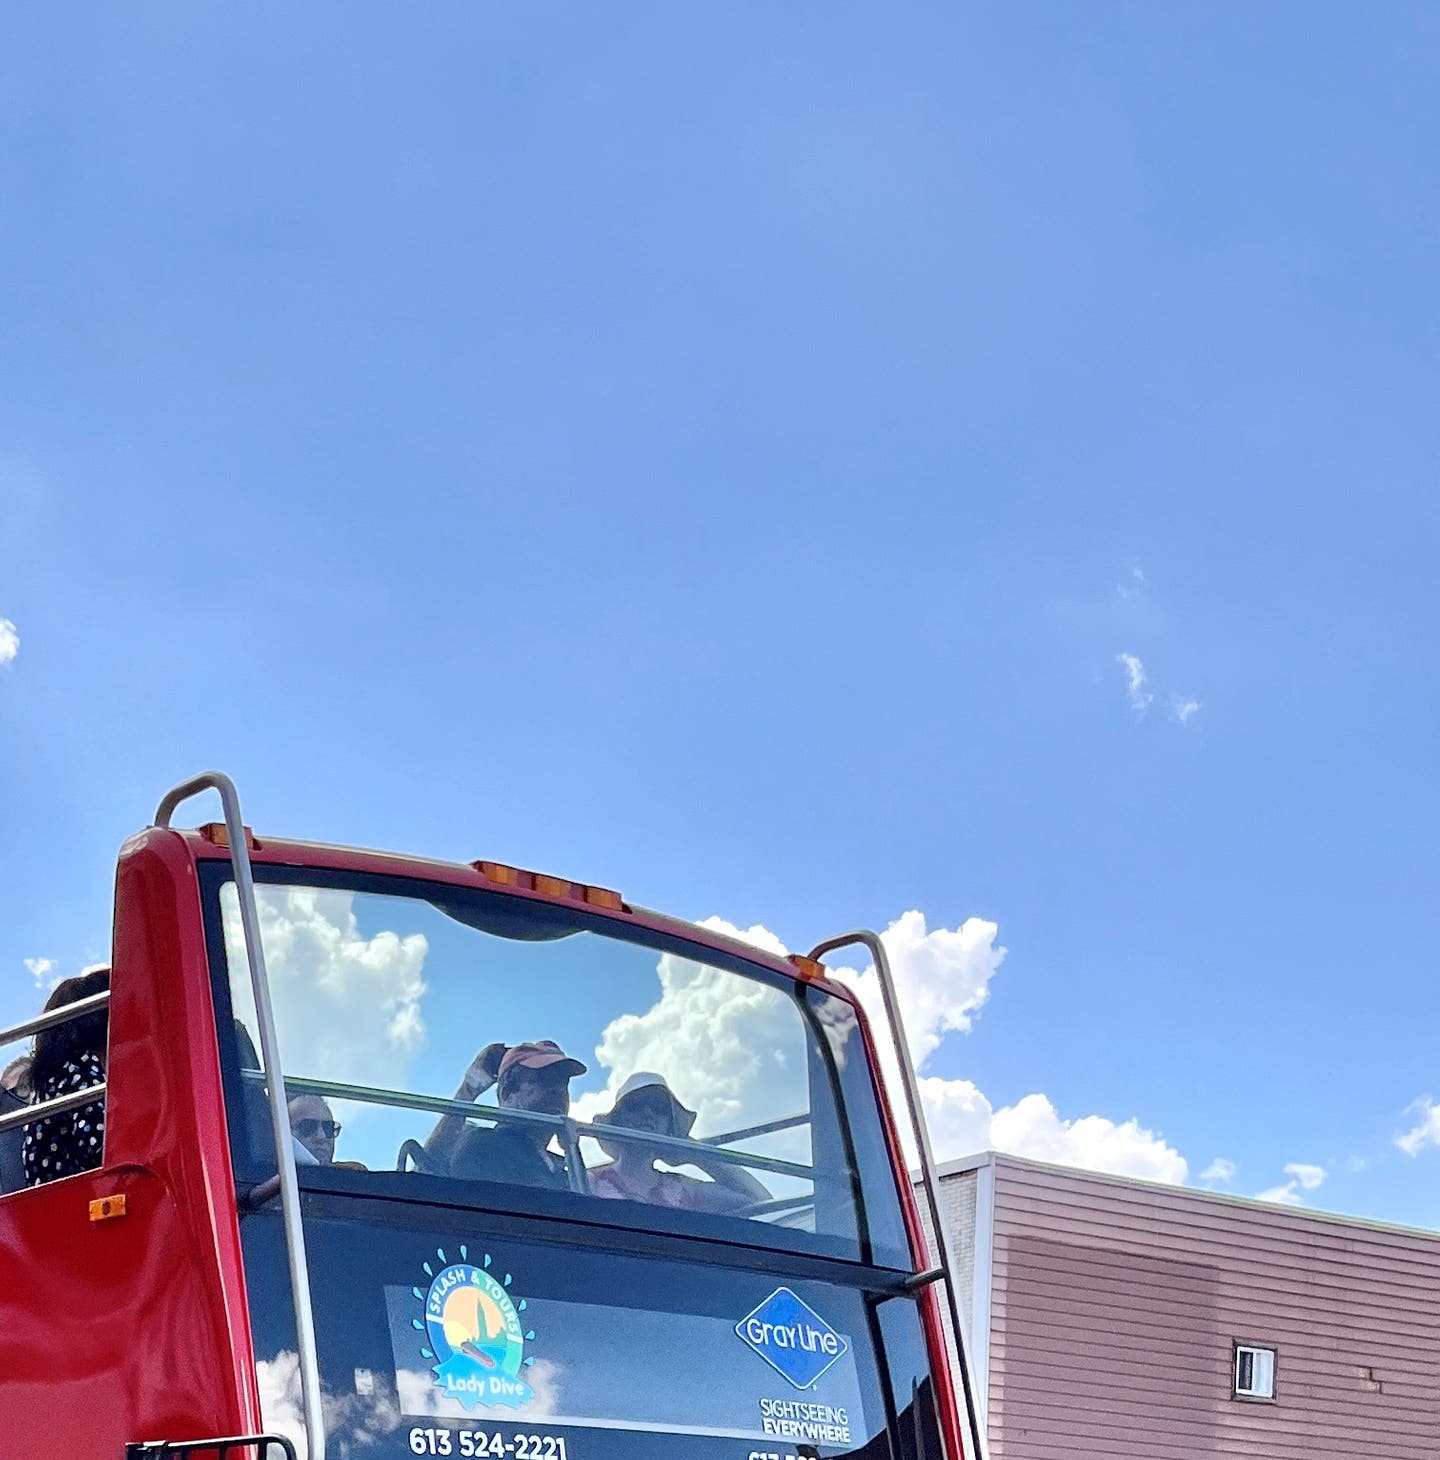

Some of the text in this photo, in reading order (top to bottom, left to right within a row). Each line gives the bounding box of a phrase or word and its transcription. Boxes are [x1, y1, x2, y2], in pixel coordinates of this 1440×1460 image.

[429, 1268, 520, 1334] SPLASH & TOURS
[446, 1373, 525, 1397] Lady Dive
[760, 1398, 848, 1425] SIGHTSEEING
[409, 1428, 452, 1456] 613
[762, 1418, 851, 1443] EVERYWHERE
